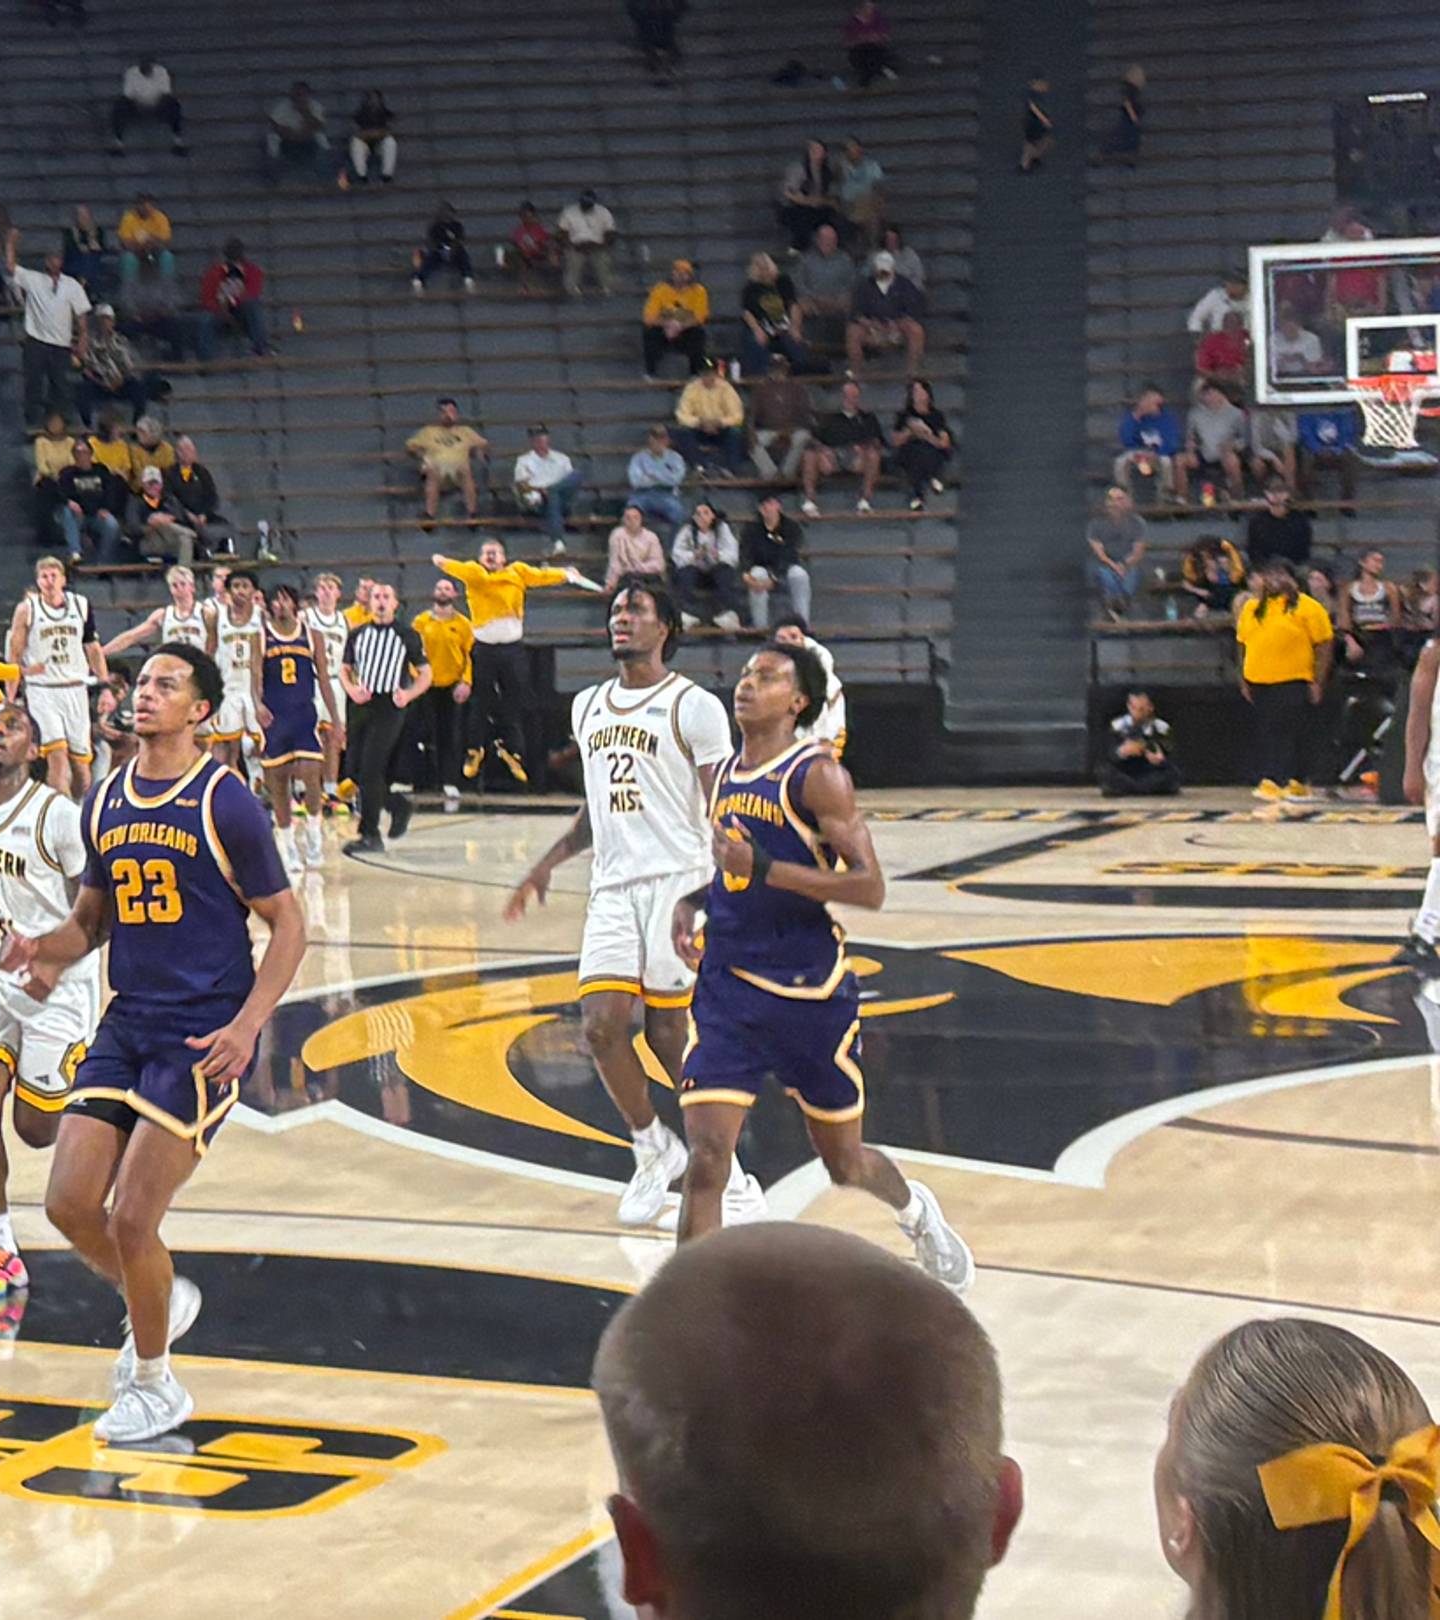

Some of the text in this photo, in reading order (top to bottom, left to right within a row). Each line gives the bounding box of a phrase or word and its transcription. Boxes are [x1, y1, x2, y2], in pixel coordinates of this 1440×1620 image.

[588, 725, 659, 758] SOUTHERN
[607, 752, 637, 784] 22
[100, 822, 198, 858] NEW ORLEANS
[111, 858, 183, 924] 23
